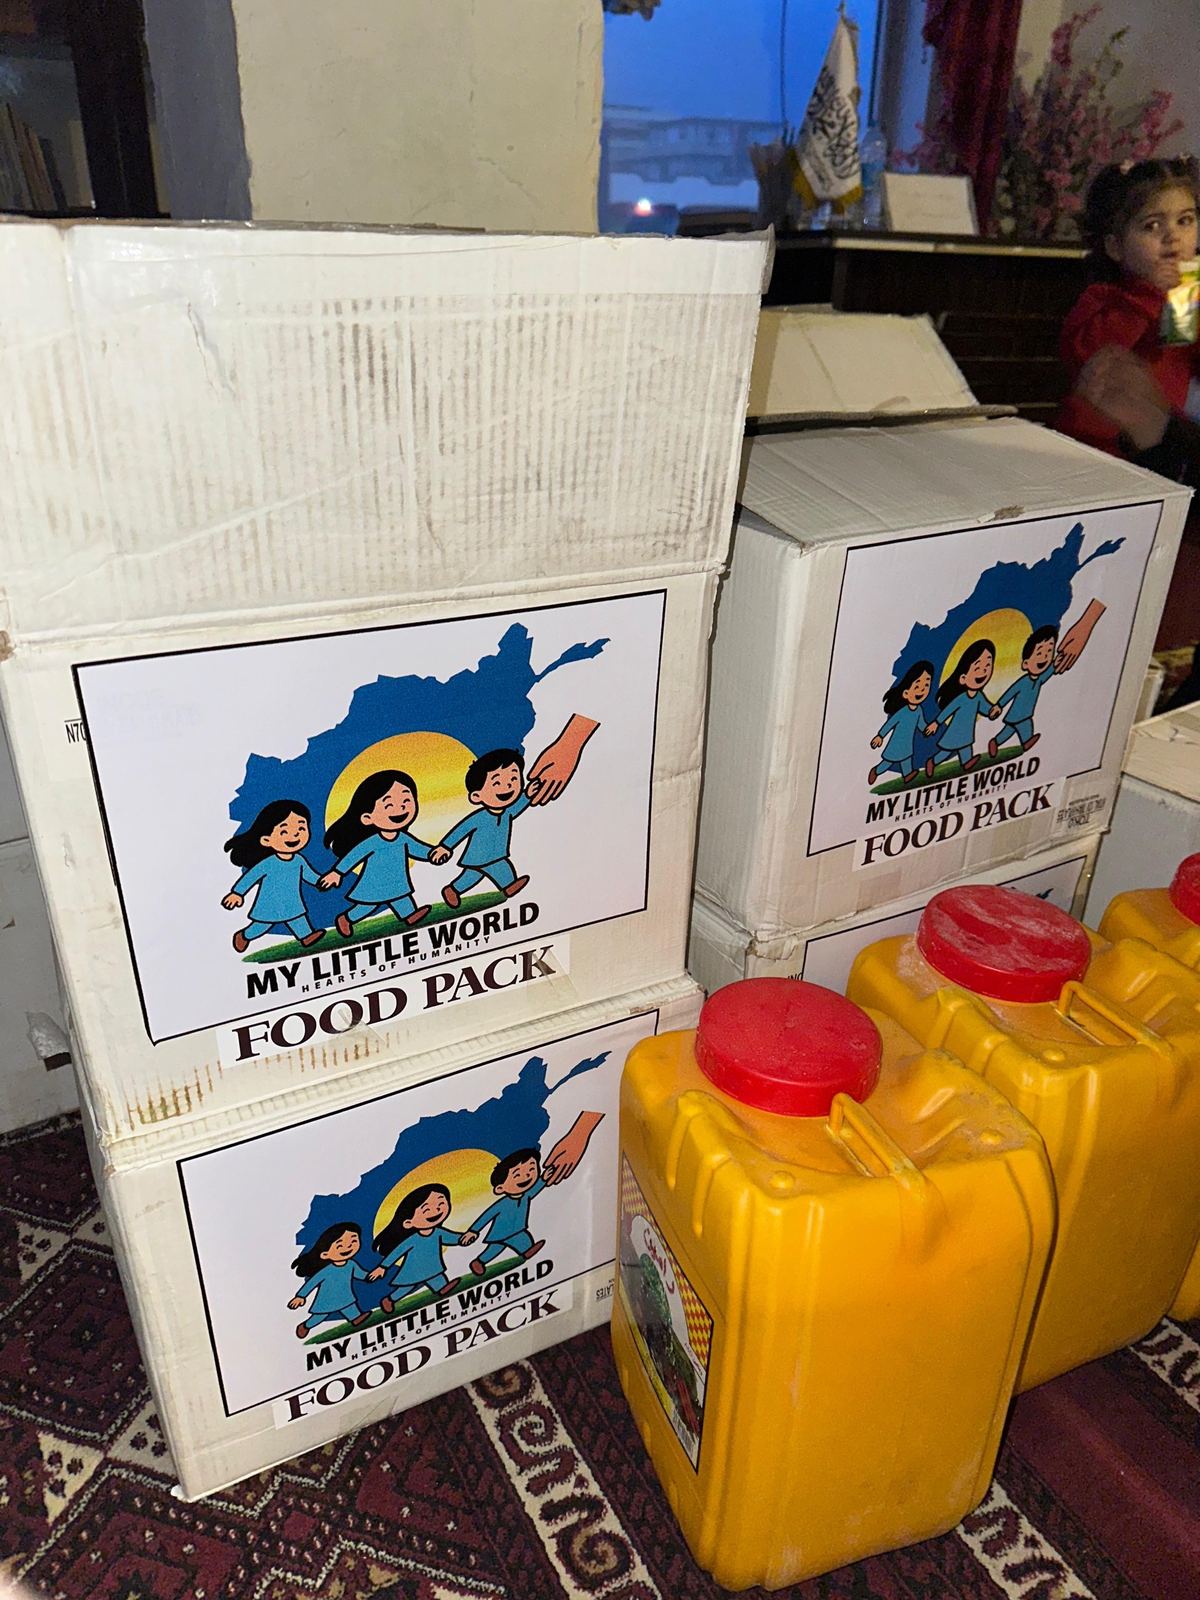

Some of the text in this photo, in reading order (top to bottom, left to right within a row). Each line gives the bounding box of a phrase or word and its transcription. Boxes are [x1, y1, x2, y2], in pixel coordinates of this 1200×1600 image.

[861, 811, 964, 866] FOOD
[969, 783, 1054, 832] PACK
[865, 757, 1041, 824] MY LITTLE WORLD
[894, 805, 934, 822] HEARTS
[246, 902, 540, 999] MY LITTLE WORLD
[301, 935, 492, 993] HEARTS OF HUMANITY
[231, 944, 557, 1062] FOOD PACK
[284, 1289, 561, 1423] FOOD PACK
[306, 1259, 554, 1371] MY LITTLE WORLD
[351, 1291, 512, 1361] HEARTS OF HUMANITY
